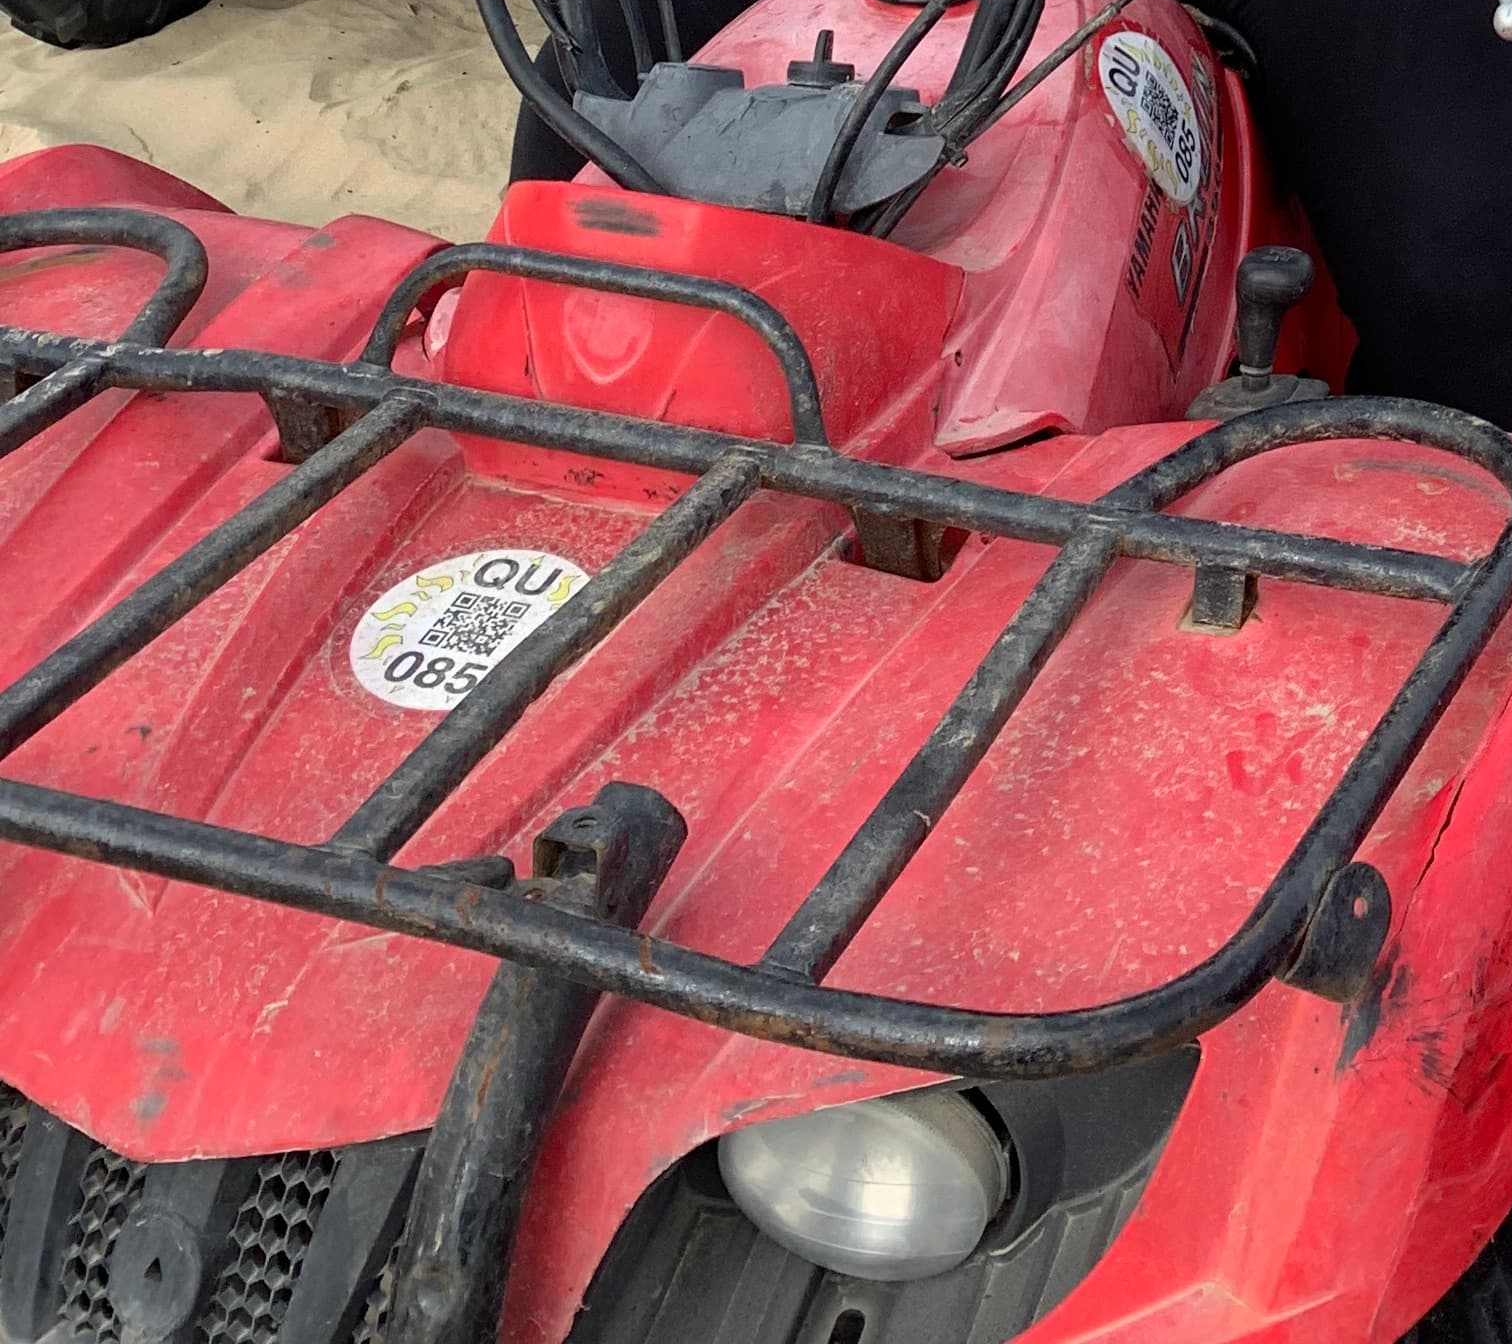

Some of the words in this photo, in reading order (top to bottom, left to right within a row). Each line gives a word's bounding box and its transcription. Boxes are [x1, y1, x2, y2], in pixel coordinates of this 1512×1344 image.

[1109, 46, 1141, 98] QU
[1175, 119, 1196, 185] 085
[472, 558, 563, 596] QU
[383, 651, 489, 694] 085
